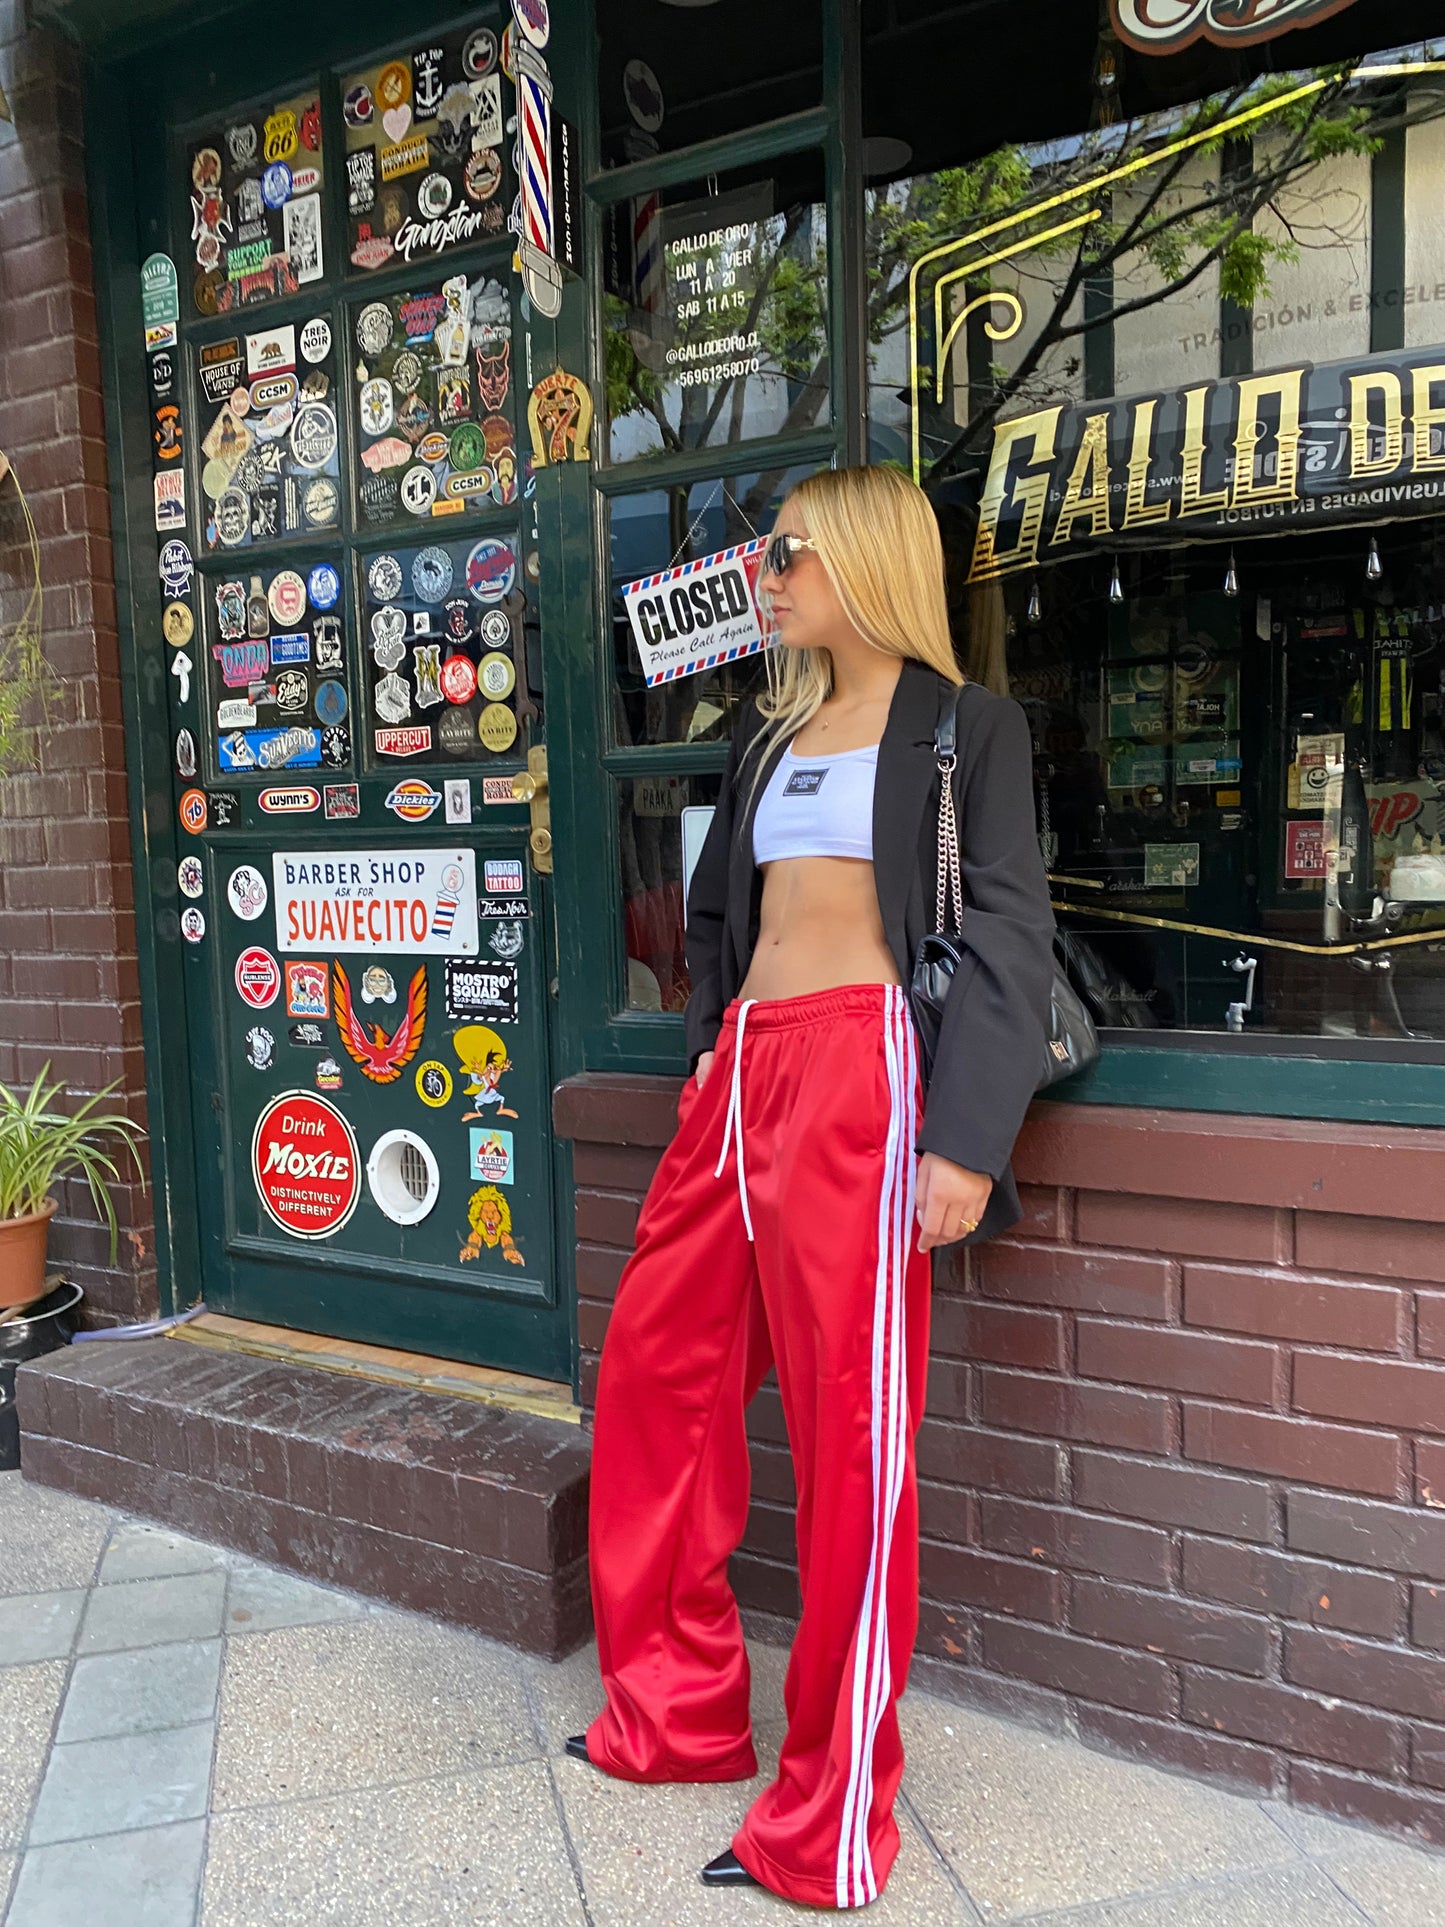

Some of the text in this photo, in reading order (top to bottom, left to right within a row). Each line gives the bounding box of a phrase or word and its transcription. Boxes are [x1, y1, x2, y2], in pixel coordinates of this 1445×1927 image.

[269, 130, 293, 157] 66
[672, 222, 750, 256] GALLO DE ORO
[676, 249, 752, 282] LUN A VIER
[689, 271, 736, 295] 11 A 20
[677, 291, 745, 319] SAB 11 A 15
[1178, 285, 1445, 353] TRADICIÓN & EXCELE
[305, 325, 327, 338] TRES
[303, 335, 328, 350] NOIR
[205, 365, 229, 385] HOUSE
[230, 363, 241, 377] OF
[259, 384, 288, 400] CCSM
[452, 476, 483, 491] CCSM
[963, 368, 1305, 585] GALLO
[637, 569, 749, 646] CLOSED
[650, 623, 753, 665] Please Call Again
[378, 731, 428, 750] UPPERCUT
[392, 795, 435, 805] Dickies
[187, 801, 203, 824] 76
[286, 862, 425, 884] BARBER SHOP
[488, 877, 520, 890] TATTOO
[335, 888, 373, 897] ASK FOR
[481, 900, 527, 917] Tres Noir
[288, 899, 427, 942] SUAVECITO
[453, 972, 511, 989] MOSTRO
[453, 985, 500, 999] SQUAD
[422, 1063, 444, 1073] ON TAP
[282, 1116, 327, 1137] Drink
[262, 1141, 349, 1180] MOXIE
[271, 1186, 342, 1205] DISTINCTIVELY
[279, 1201, 333, 1217] DIFFERENT
